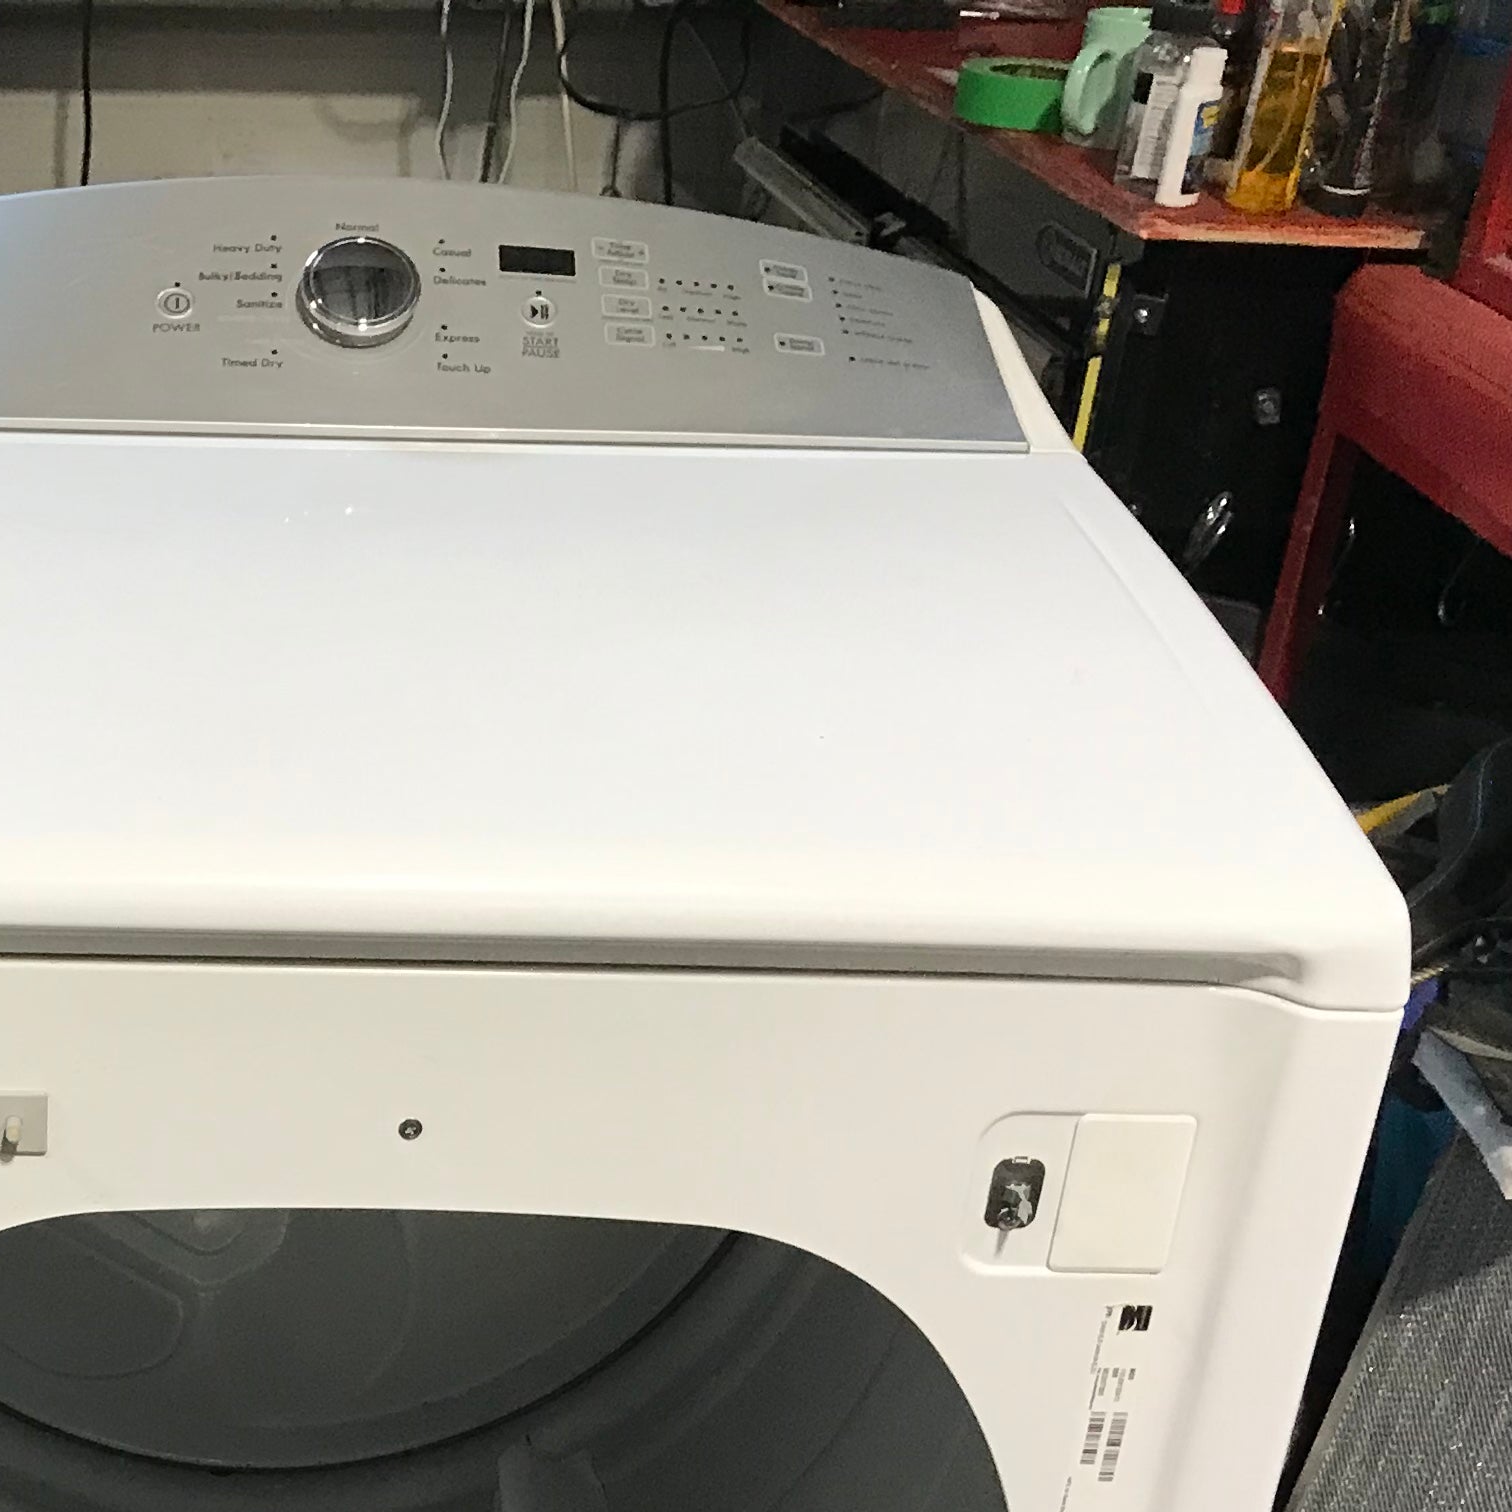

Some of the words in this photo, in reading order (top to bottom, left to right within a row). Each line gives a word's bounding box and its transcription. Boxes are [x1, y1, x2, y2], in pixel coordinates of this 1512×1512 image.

[335, 222, 380, 232] Normal
[213, 244, 250, 254] Heavy
[254, 243, 282, 254] Duty
[432, 246, 472, 257] Casual
[433, 275, 487, 287] Delicates
[236, 299, 283, 309] Sanitize
[152, 323, 201, 333] POWER
[435, 332, 481, 343] Express
[522, 336, 559, 347] START
[522, 347, 561, 359] PAUSE
[221, 358, 258, 368] Timed
[261, 358, 284, 368] Dry
[437, 361, 471, 373] Touch
[474, 363, 492, 374] Up
